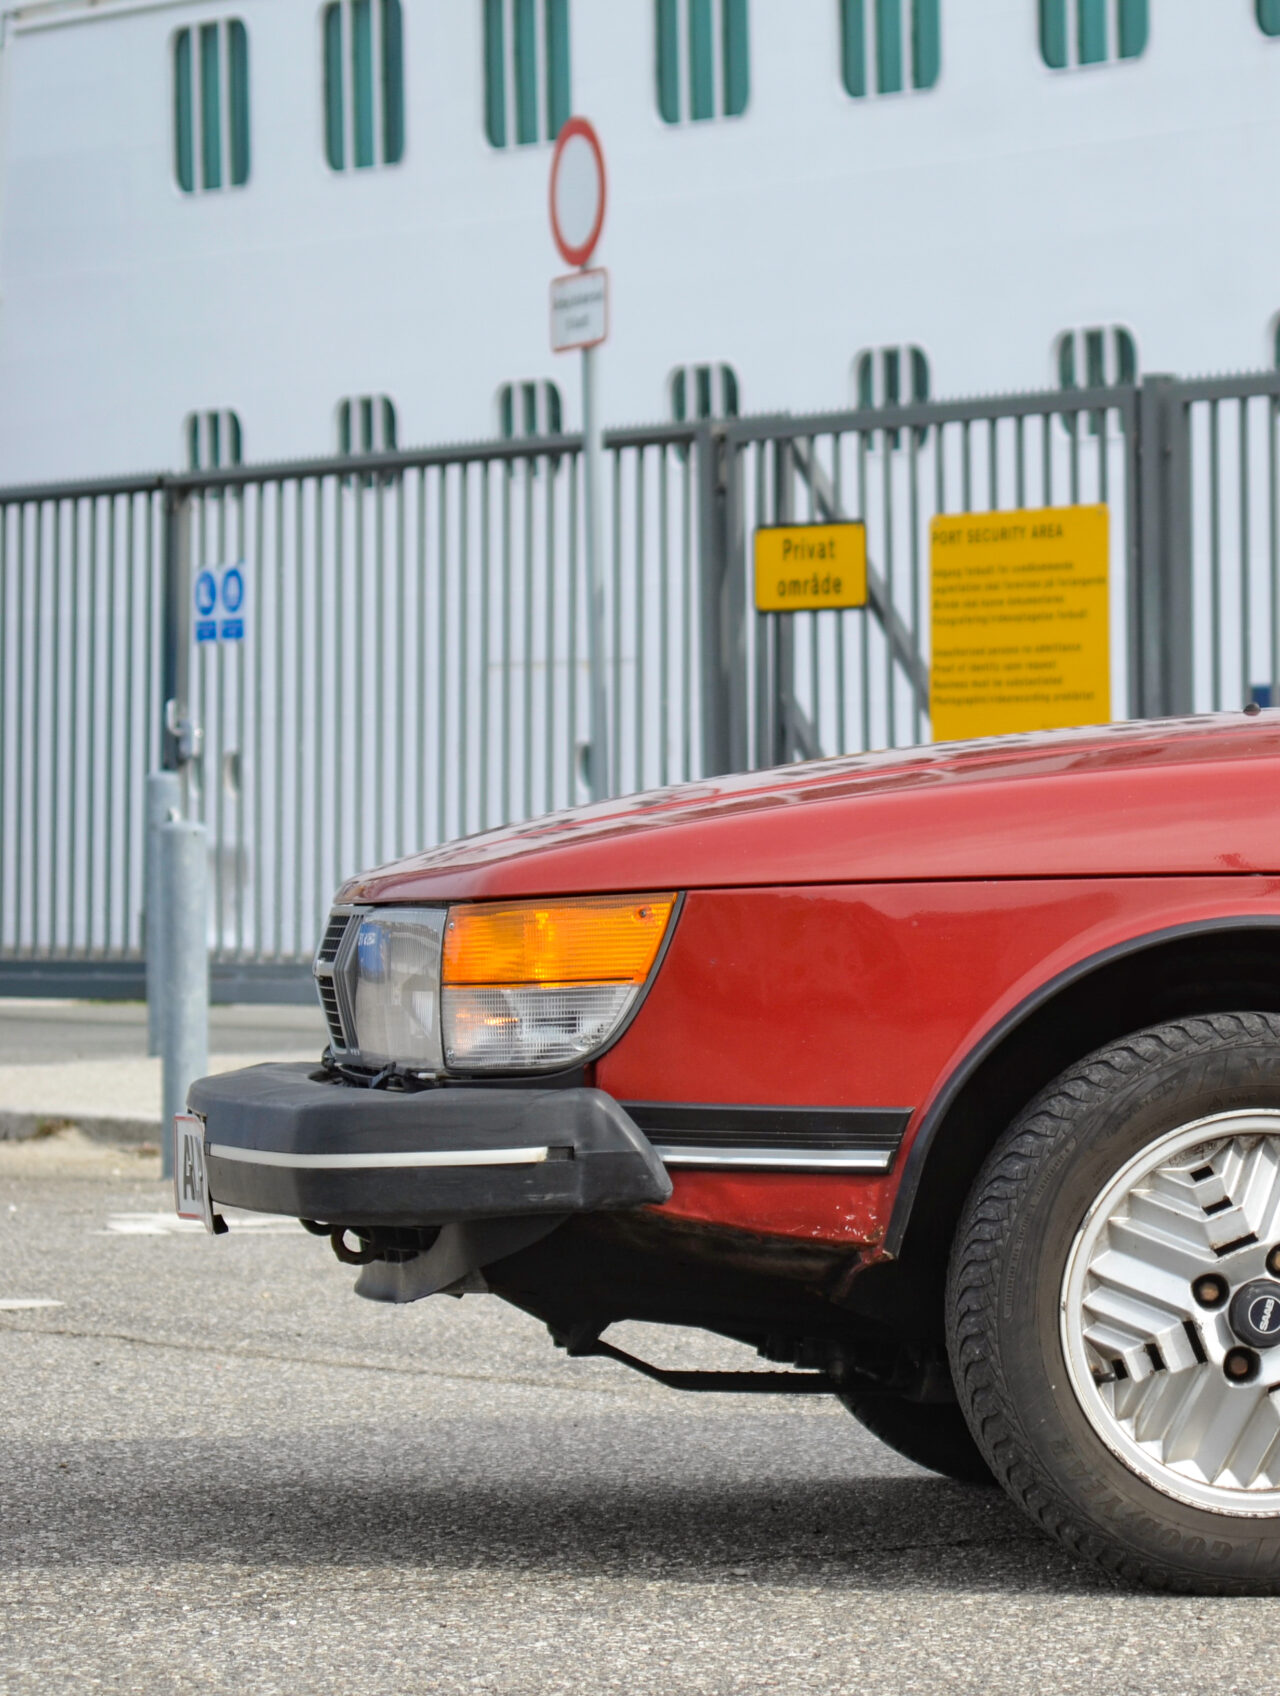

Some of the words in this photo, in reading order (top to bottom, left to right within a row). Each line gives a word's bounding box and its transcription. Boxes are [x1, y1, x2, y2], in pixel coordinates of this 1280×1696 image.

[932, 530, 963, 545] PORT
[967, 525, 1027, 544] SECURITY
[1031, 523, 1064, 539] AREA
[782, 537, 836, 561] Privat
[777, 572, 843, 597] område
[1259, 1298, 1275, 1331] SAAB
